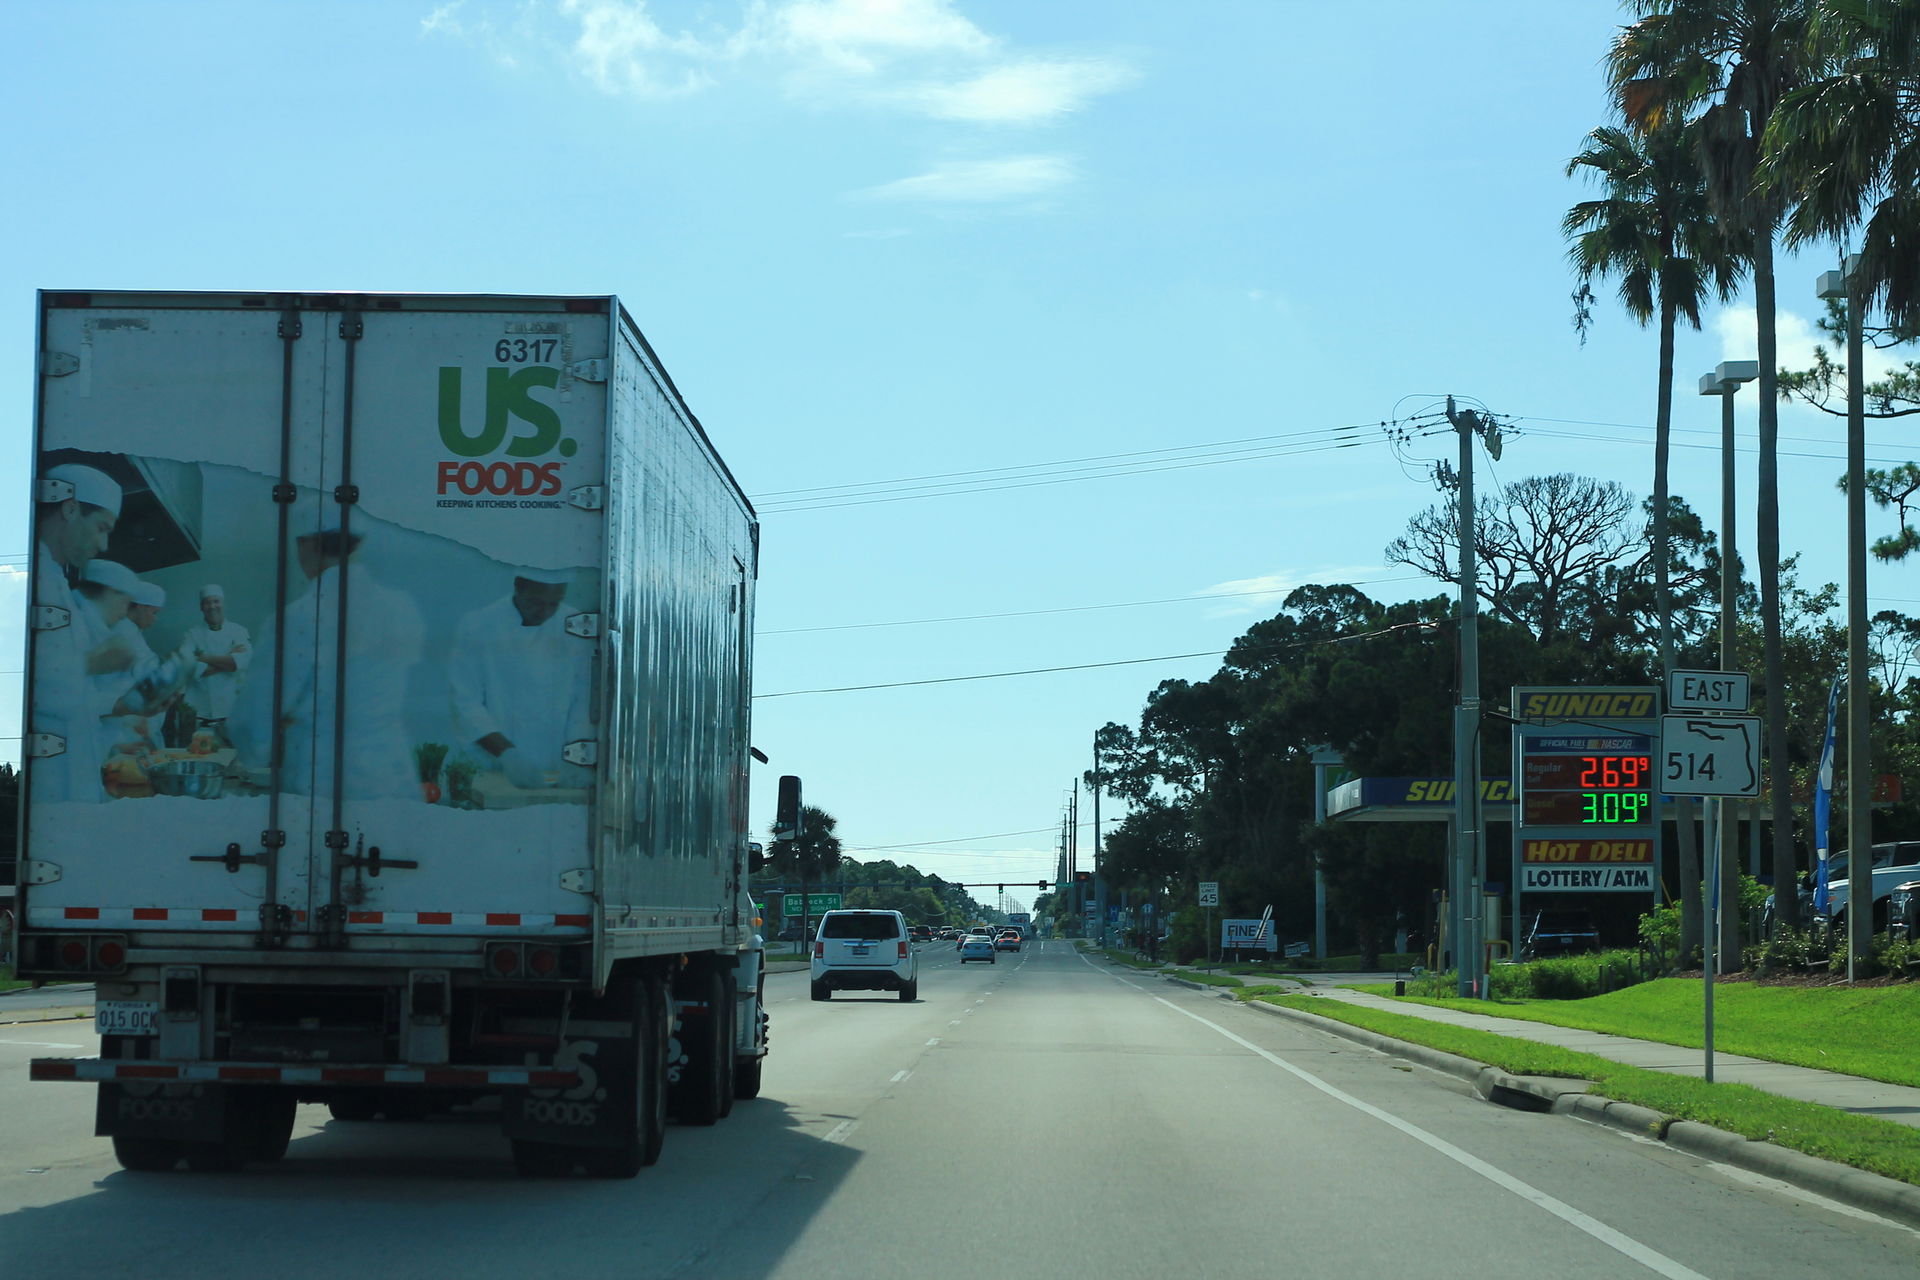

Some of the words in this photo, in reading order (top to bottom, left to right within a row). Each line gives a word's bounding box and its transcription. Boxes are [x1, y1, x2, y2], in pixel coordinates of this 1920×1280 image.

[495, 339, 558, 363] 6317
[437, 365, 578, 458] US.
[437, 461, 562, 496] FOODS
[436, 500, 473, 508] KEEPING
[476, 500, 517, 509] KITCHENS
[520, 501, 561, 509] COOKING.
[1683, 677, 1735, 703] EAST
[1524, 695, 1653, 716] SUNOCO
[1539, 739, 1568, 747] OFFICIAL
[1601, 739, 1633, 749] NASCAR
[1527, 762, 1562, 774] Regular
[1667, 752, 1715, 781] 514
[1527, 841, 1581, 861] HOT
[1589, 841, 1648, 861] DELI
[827, 897, 837, 905] St
[1200, 894, 1217, 903] 45
[524, 1100, 597, 1125] FOODS
